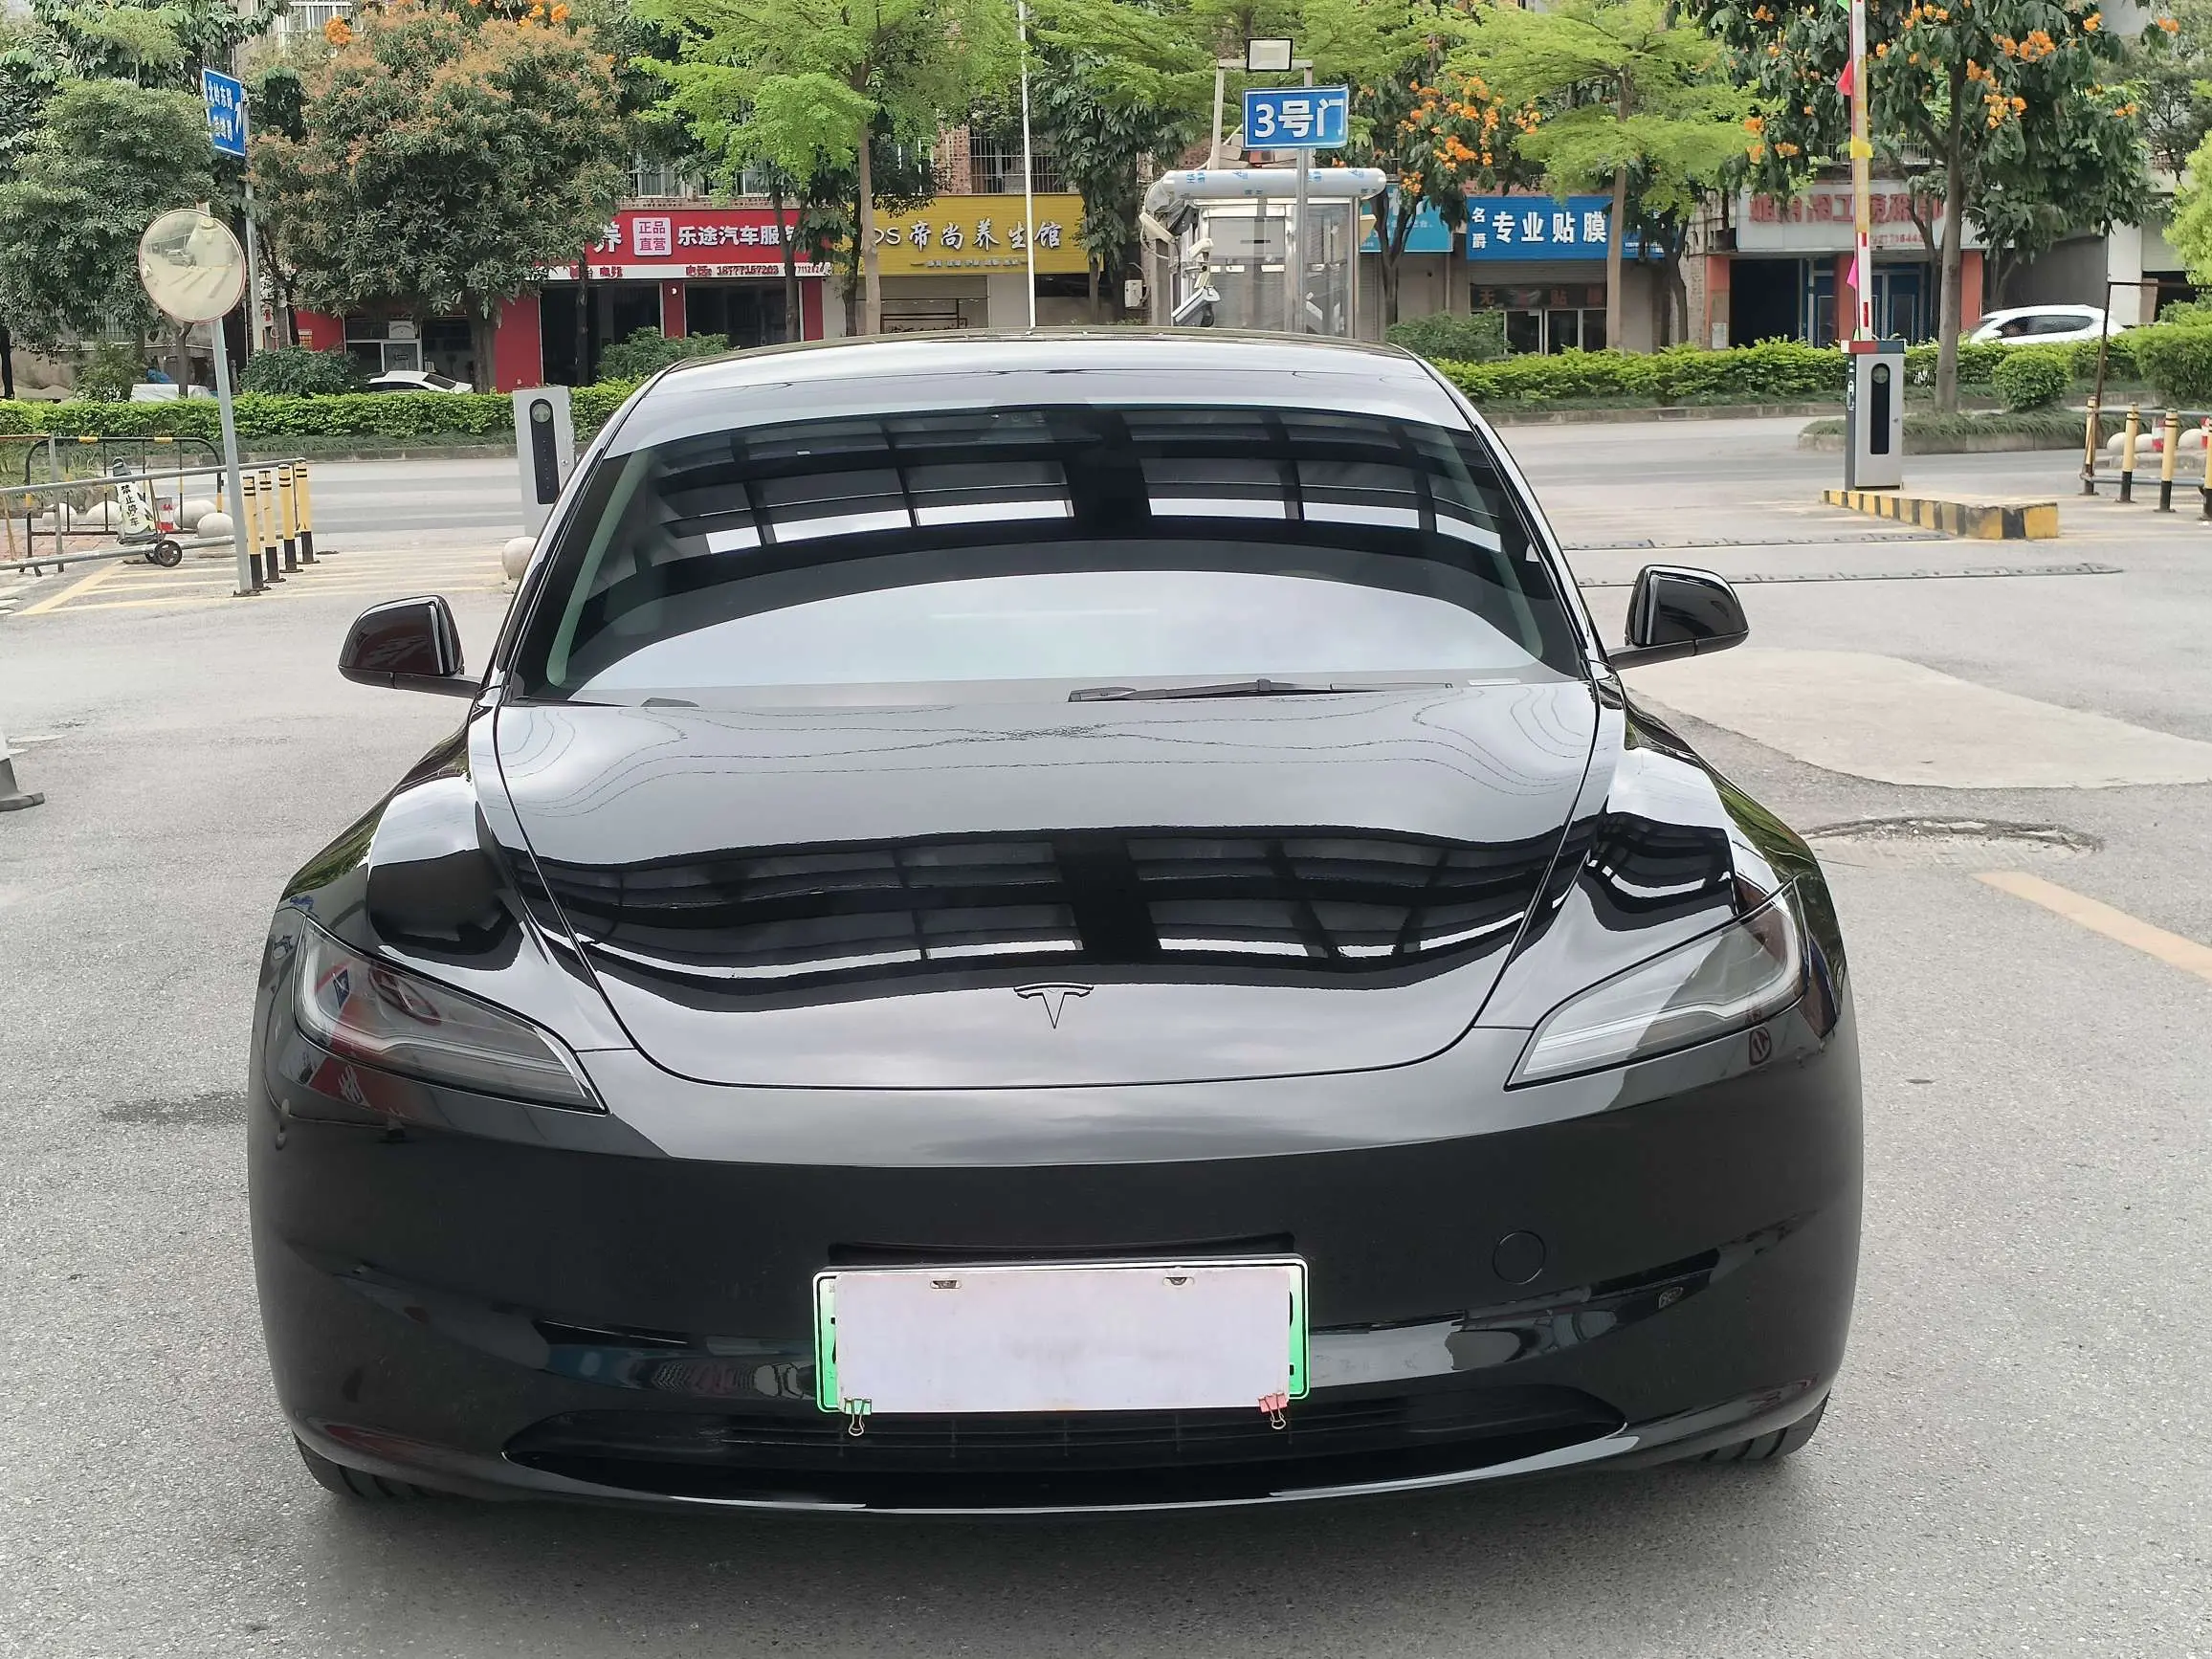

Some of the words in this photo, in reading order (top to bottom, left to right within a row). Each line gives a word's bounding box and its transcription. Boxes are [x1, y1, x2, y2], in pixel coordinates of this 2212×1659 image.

[1254, 99, 1344, 139] 3号门
[638, 221, 666, 234] 正品
[1492, 210, 1607, 245] 专业贴膜
[639, 237, 666, 251] 直营
